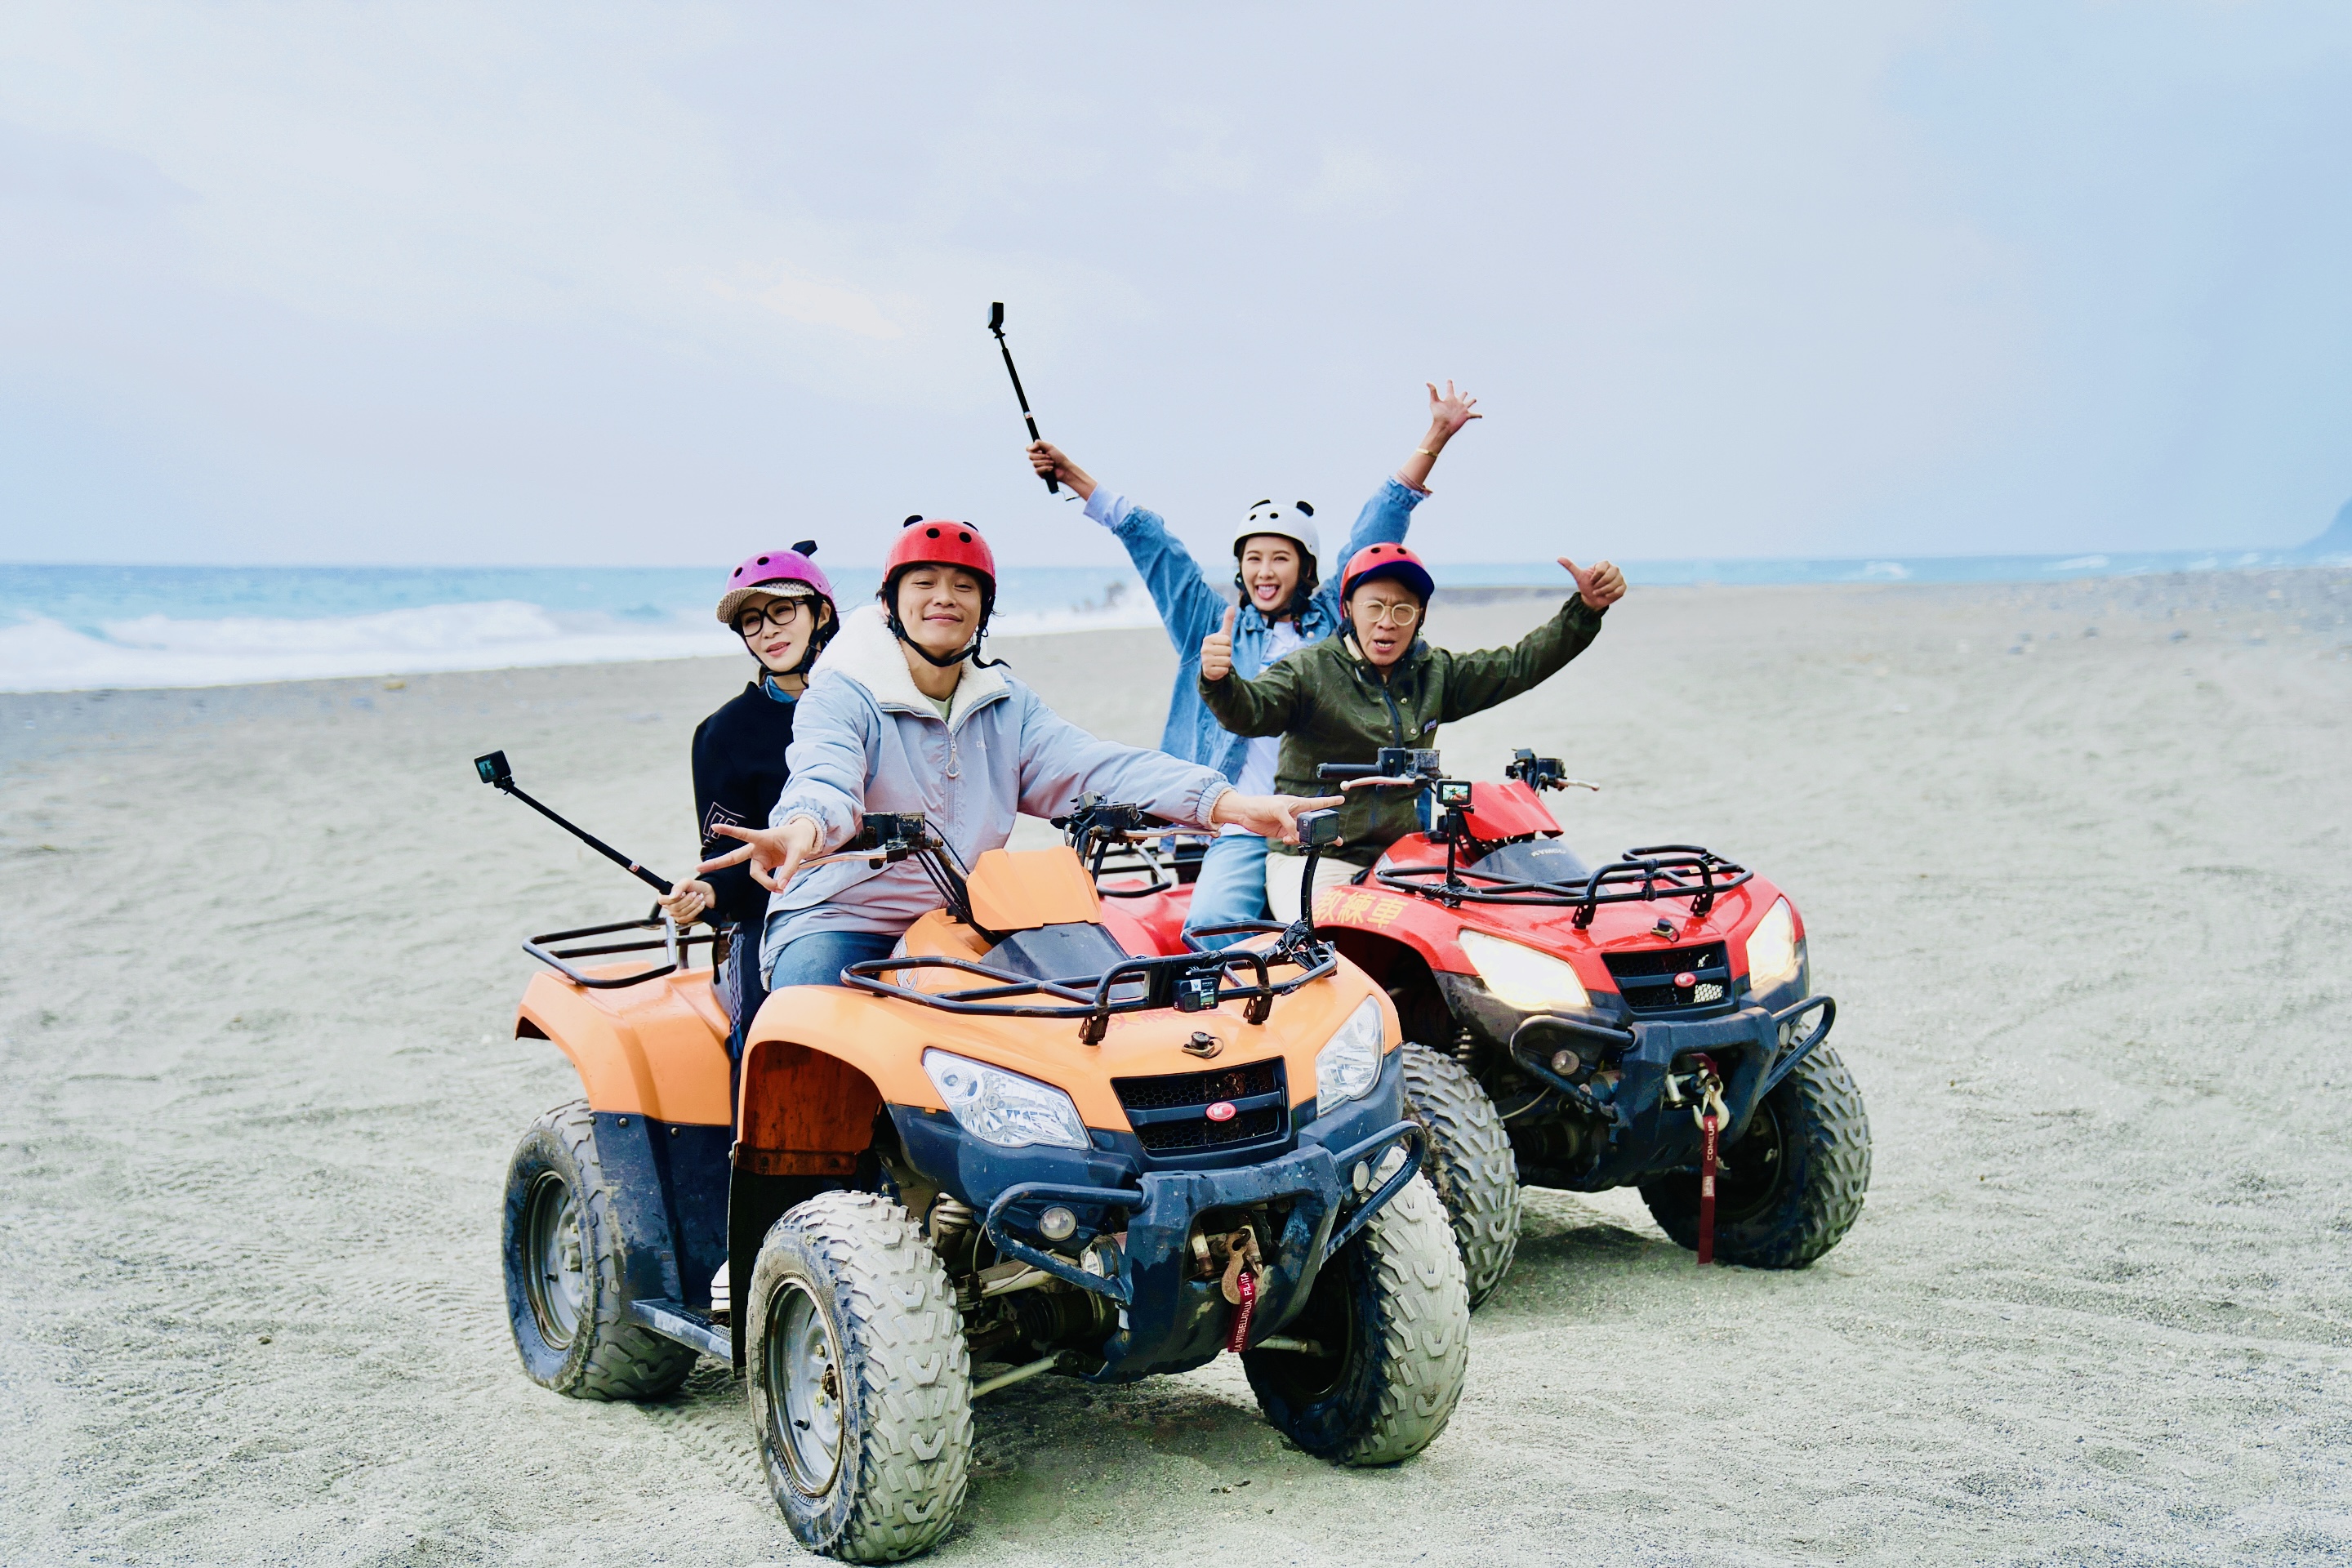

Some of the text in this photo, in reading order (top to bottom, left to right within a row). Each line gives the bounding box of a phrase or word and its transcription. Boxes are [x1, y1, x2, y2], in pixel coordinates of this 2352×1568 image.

[1312, 889, 1409, 929] 教練車
[1706, 1120, 1715, 1160] COMEUP
